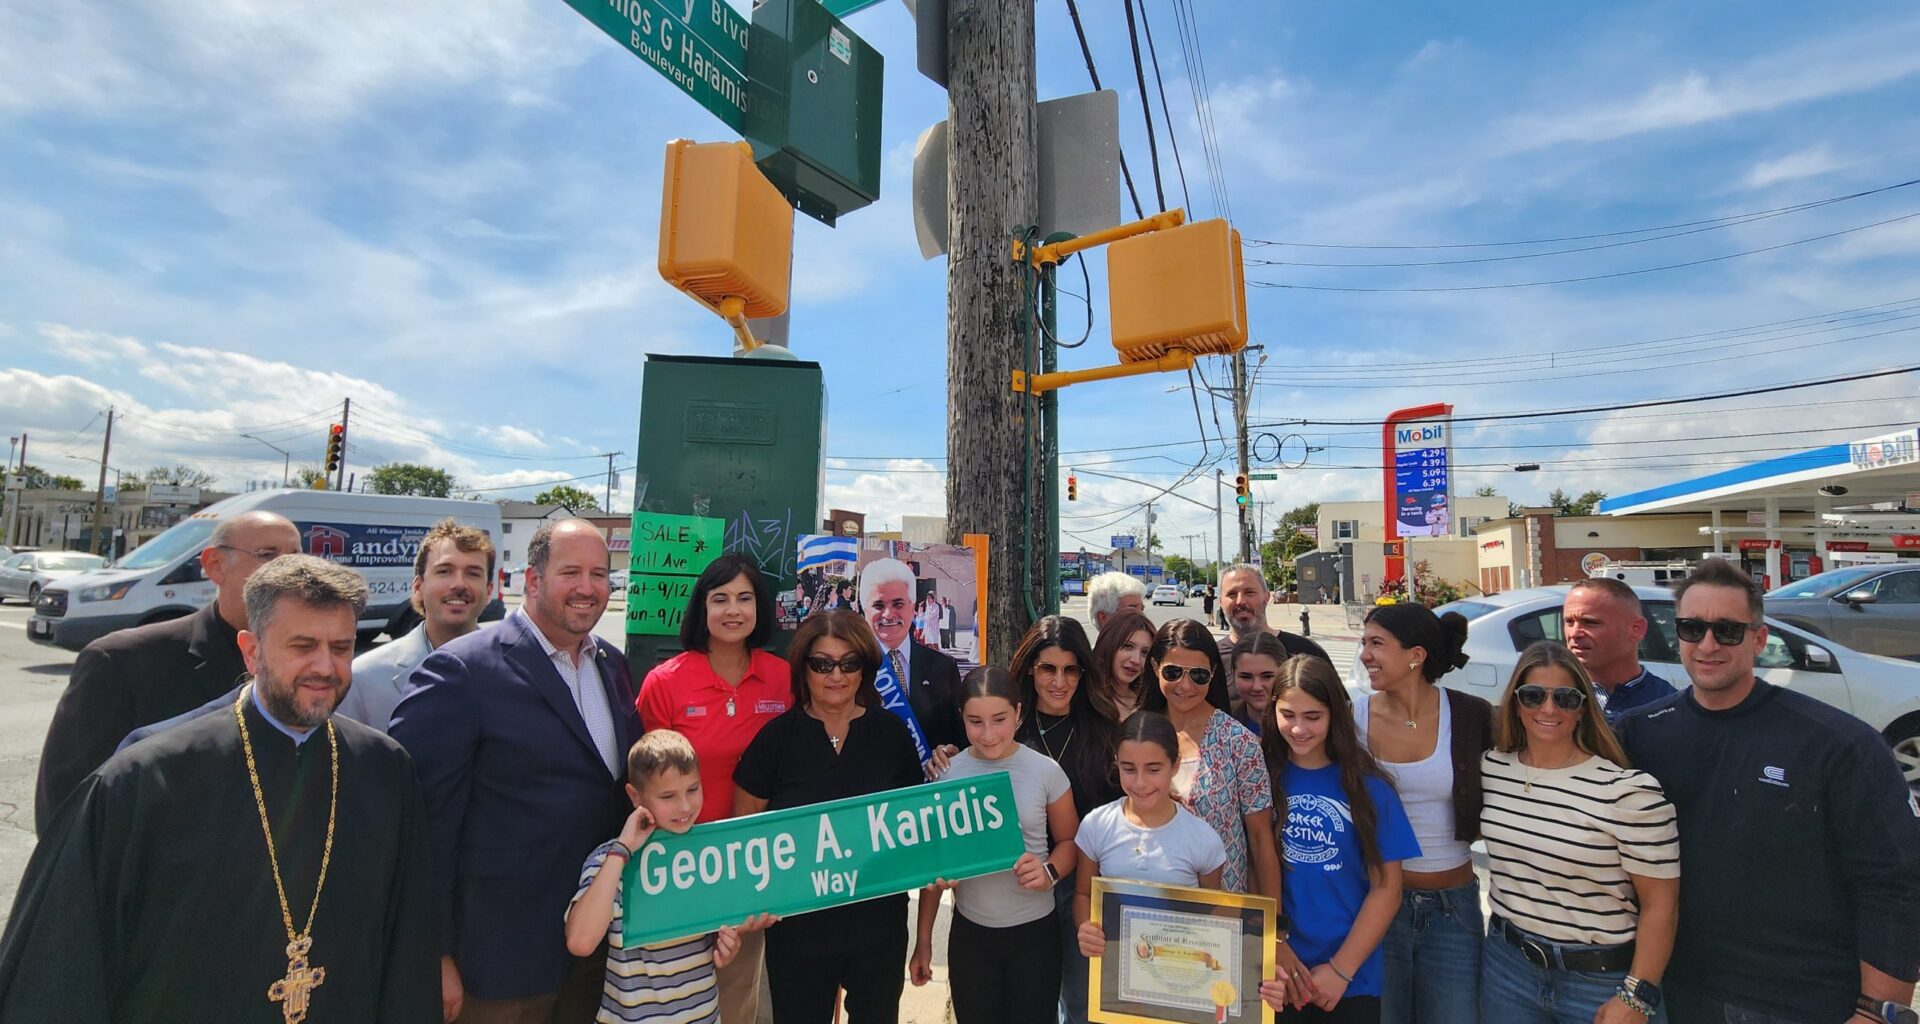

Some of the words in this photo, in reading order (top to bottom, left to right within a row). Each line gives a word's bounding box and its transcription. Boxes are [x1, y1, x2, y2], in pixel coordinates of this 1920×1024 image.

[711, 0, 750, 51] Blvd
[630, 28, 695, 92] Boulevard
[660, 17, 673, 52] G
[680, 33, 748, 113] Haramis
[1398, 424, 1442, 445] Mobil
[1421, 449, 1440, 458] 4.29
[1852, 435, 1914, 467] Mobil
[1421, 458, 1441, 467] 4.39
[1422, 468, 1441, 478] 5.09
[1422, 478, 1441, 487] 6.39
[641, 521, 690, 543] SALE
[662, 552, 688, 570] Ave
[1287, 812, 1324, 829] GREEK
[639, 831, 797, 896] George
[815, 813, 853, 864] A.
[866, 786, 1004, 852] Karidis
[810, 869, 858, 898] Way
